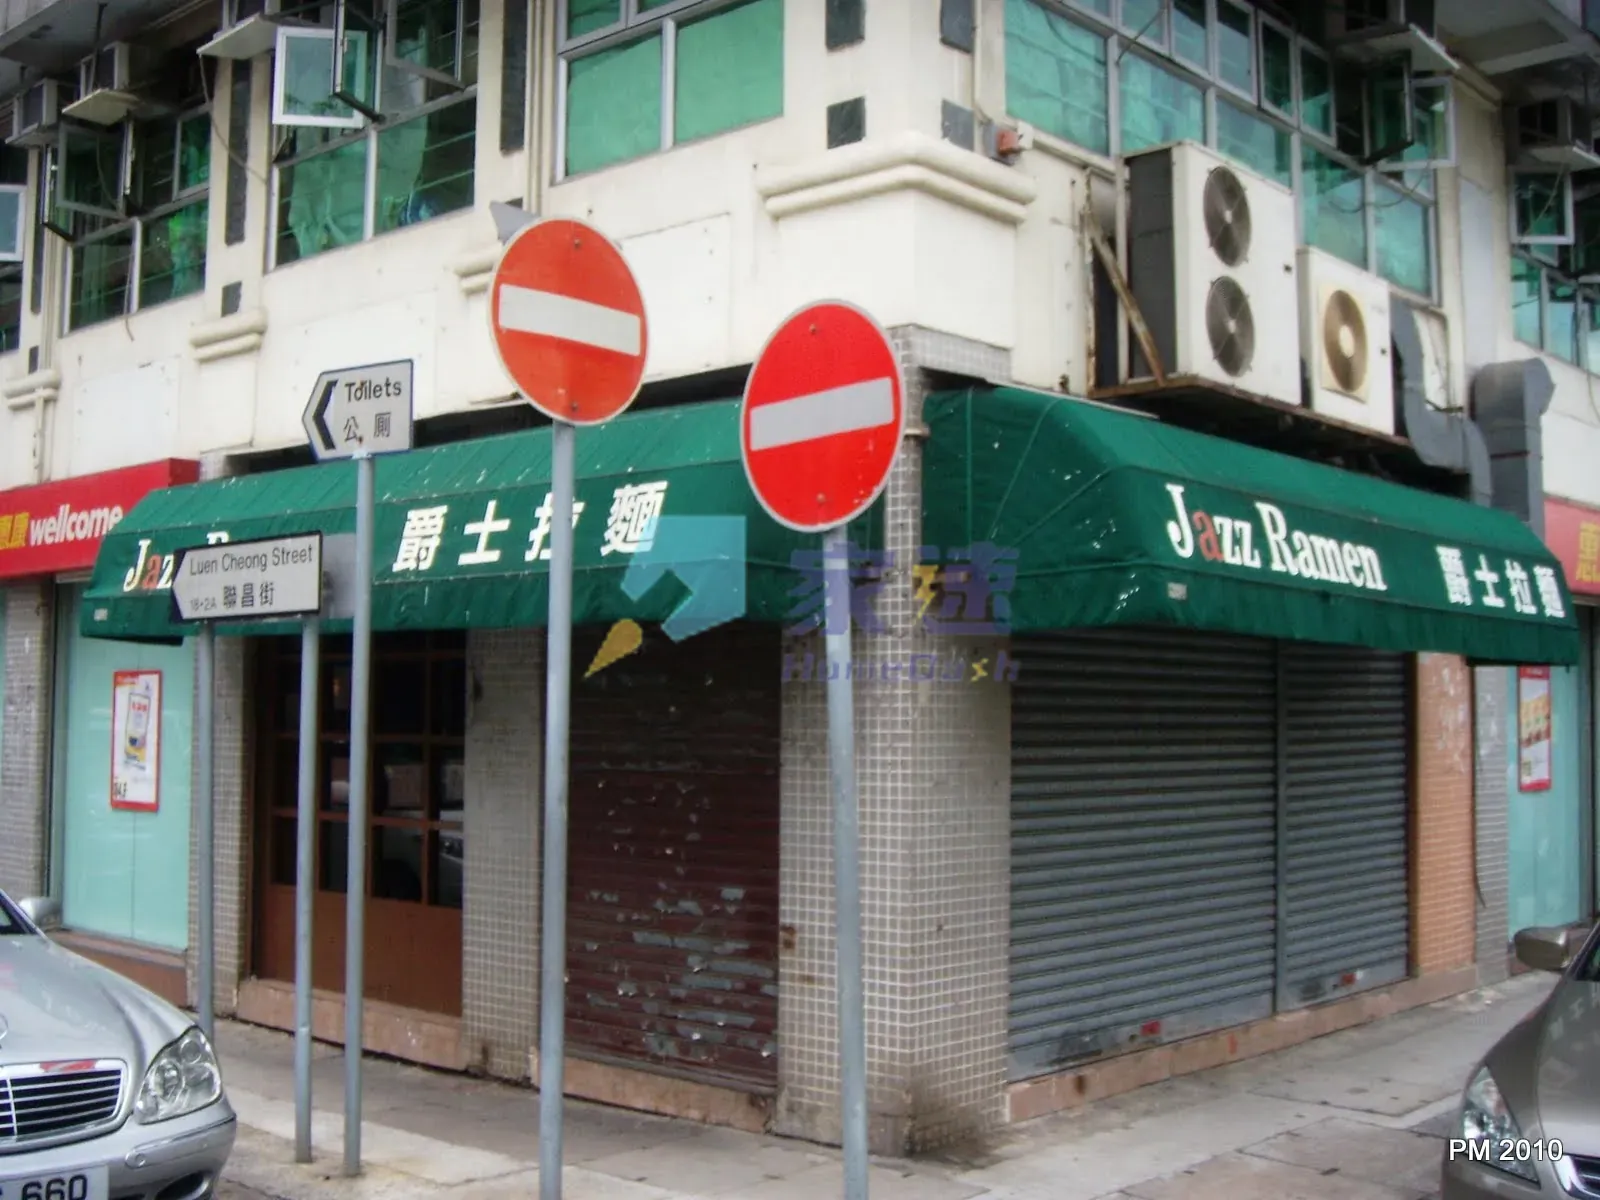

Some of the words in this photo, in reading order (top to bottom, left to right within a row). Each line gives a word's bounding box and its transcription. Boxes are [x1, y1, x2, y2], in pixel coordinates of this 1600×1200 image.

[344, 376, 402, 402] Toilets
[30, 504, 123, 546] wellcome
[1165, 483, 1262, 569] Jazz
[1254, 501, 1388, 591] Ramen
[123, 537, 174, 592] Jaz
[190, 556, 218, 575] Luen
[221, 553, 268, 572] Cheong
[272, 544, 313, 566] Street
[223, 581, 275, 609] 聯昌街
[22, 1174, 88, 1200] 660
